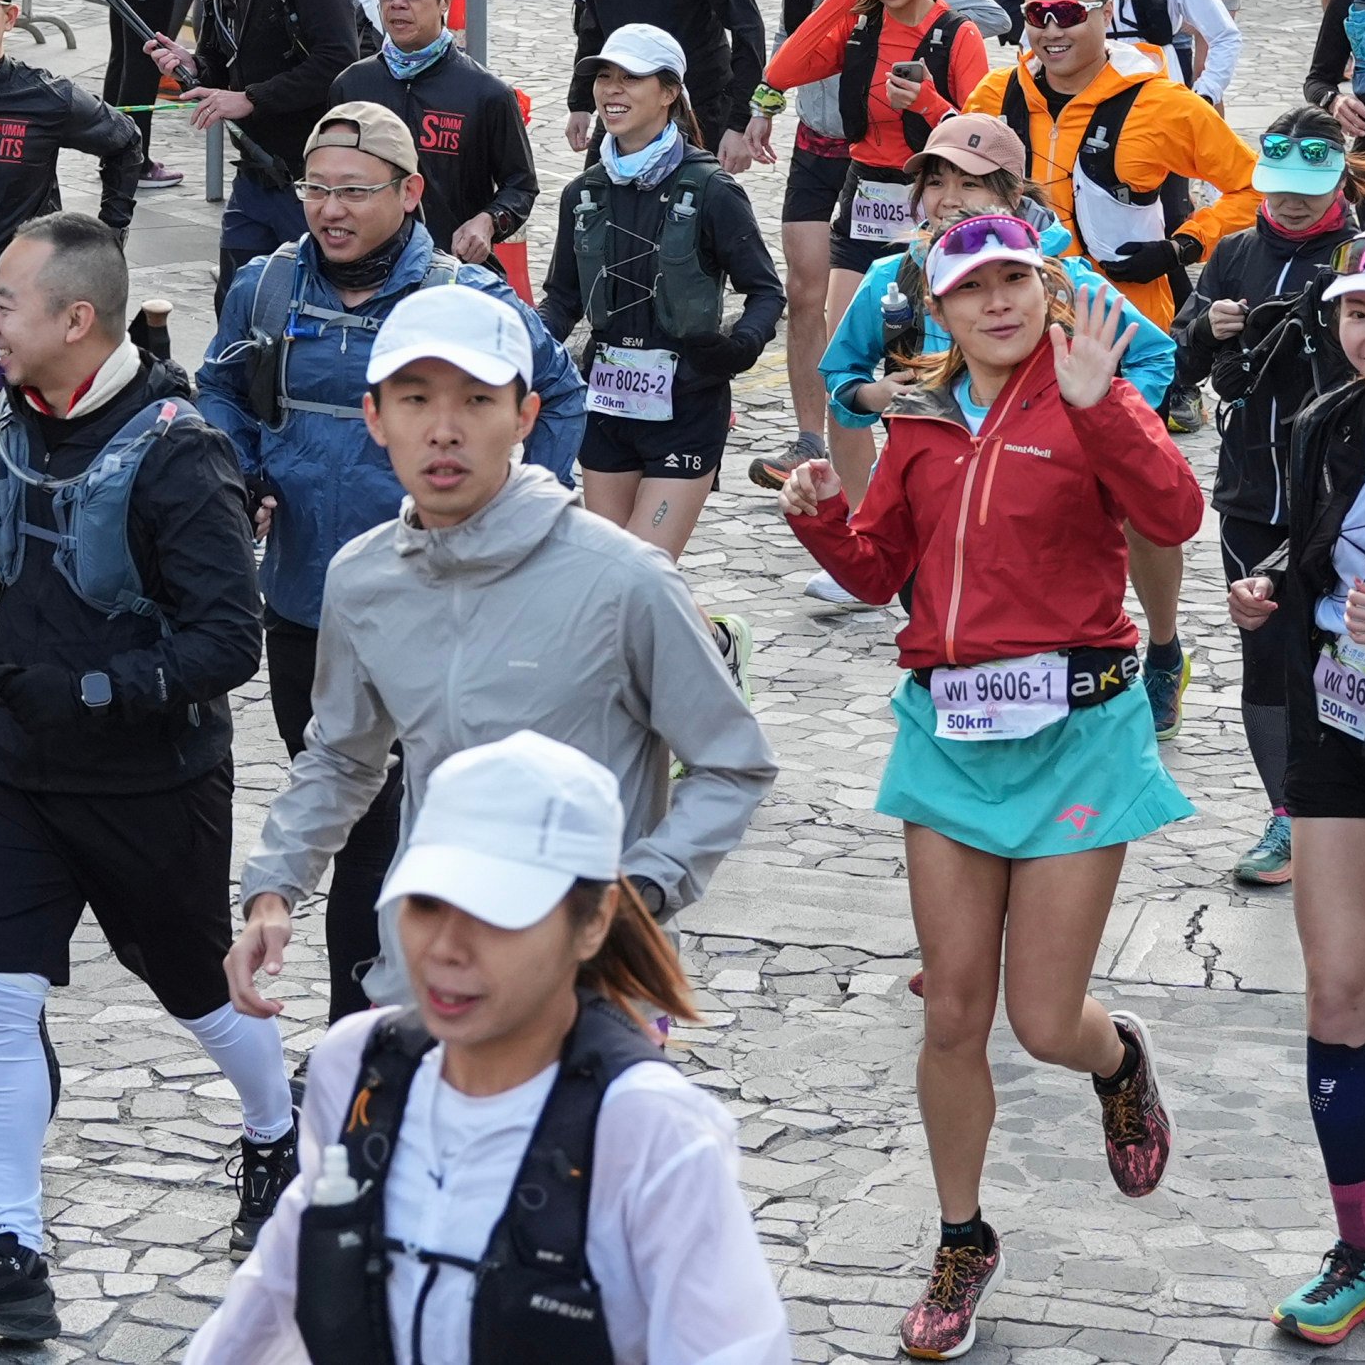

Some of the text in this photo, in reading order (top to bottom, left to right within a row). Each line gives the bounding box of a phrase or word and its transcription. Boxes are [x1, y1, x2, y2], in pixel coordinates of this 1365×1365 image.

[855, 204, 871, 218] WT
[856, 223, 884, 235] 50km
[596, 369, 667, 395] WT 8025-2
[593, 395, 625, 409] 50km
[682, 454, 702, 471] T8
[944, 671, 1052, 702] WI 9606-1
[1321, 698, 1358, 726] 50km
[946, 714, 993, 730] 50km
